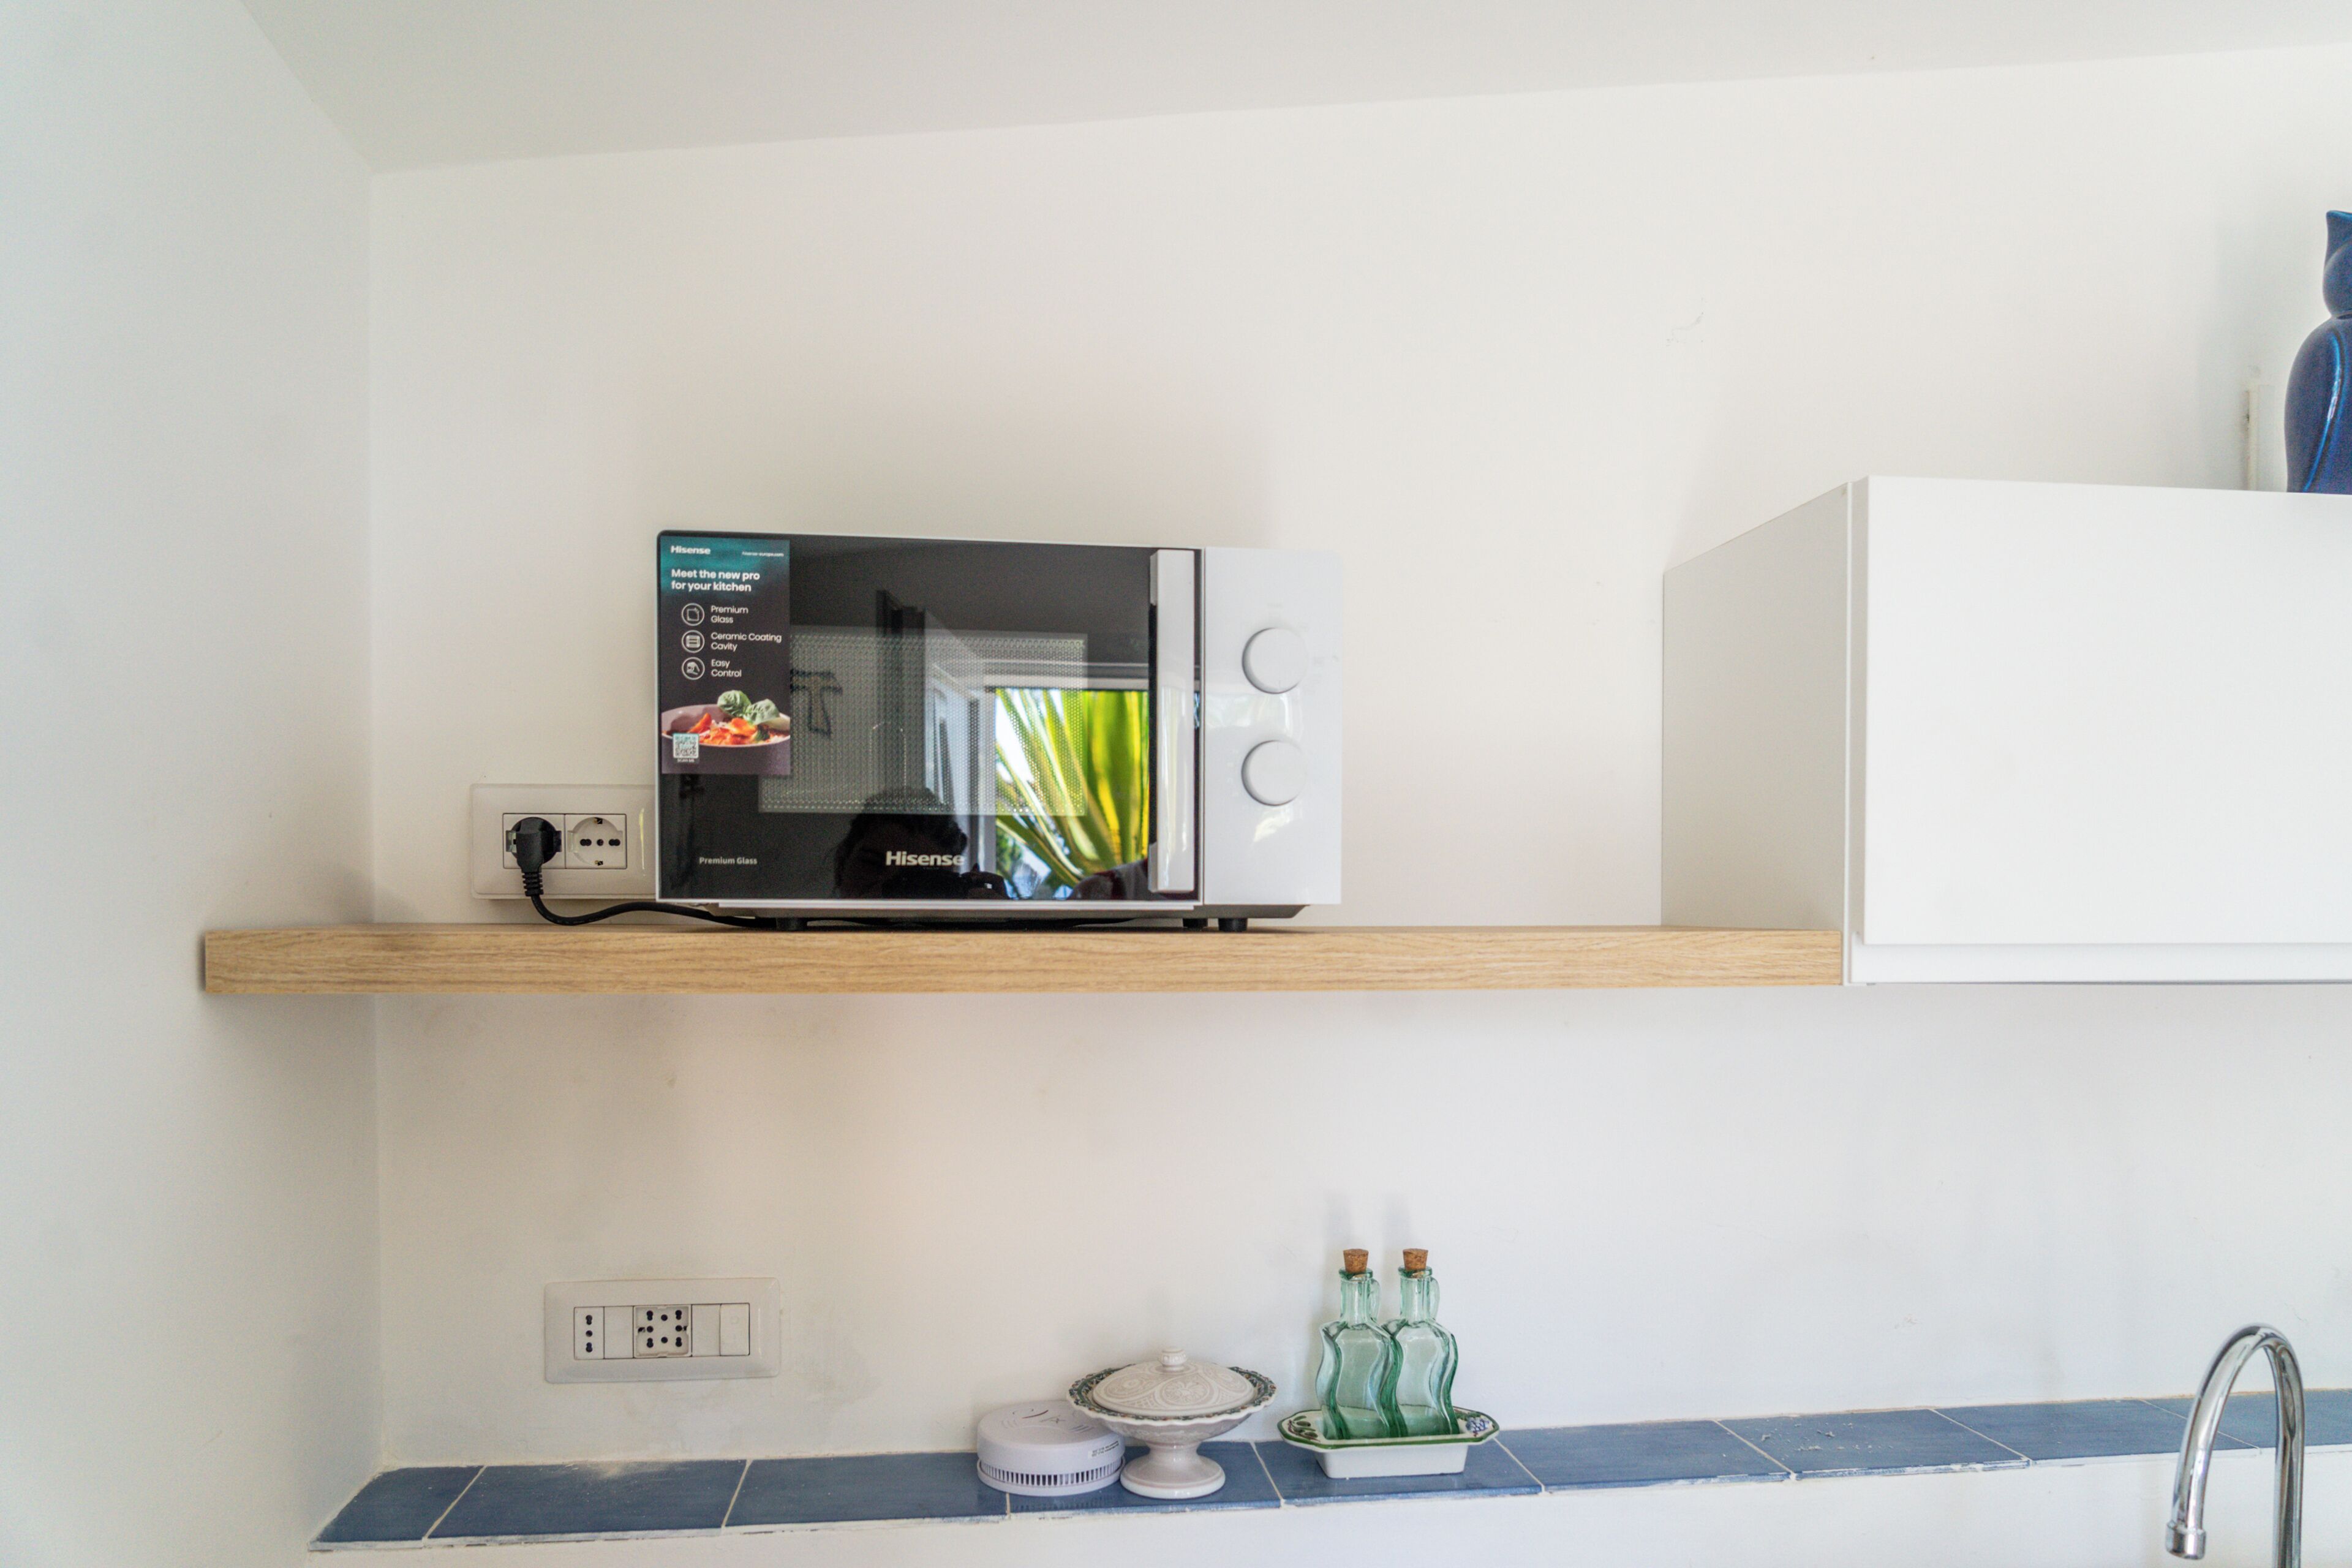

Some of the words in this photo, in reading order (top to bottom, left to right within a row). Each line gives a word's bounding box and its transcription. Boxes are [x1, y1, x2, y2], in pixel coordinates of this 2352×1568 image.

[671, 545, 711, 555] Hisense
[671, 569, 697, 578] Meet
[699, 570, 717, 579] the
[718, 571, 741, 579] new
[742, 572, 760, 582] pro
[671, 580, 686, 589] for
[688, 582, 711, 592] your
[713, 581, 752, 592] kitchen
[711, 605, 748, 614] Premium
[710, 615, 734, 624] Glass
[710, 632, 747, 641] Ceramic
[748, 633, 782, 643] Coating
[710, 642, 738, 652] Cavity
[711, 659, 730, 669] Easy
[711, 669, 742, 677] Control
[699, 856, 735, 865] Premium
[736, 856, 758, 865] Glass
[886, 850, 965, 866] Hisense
